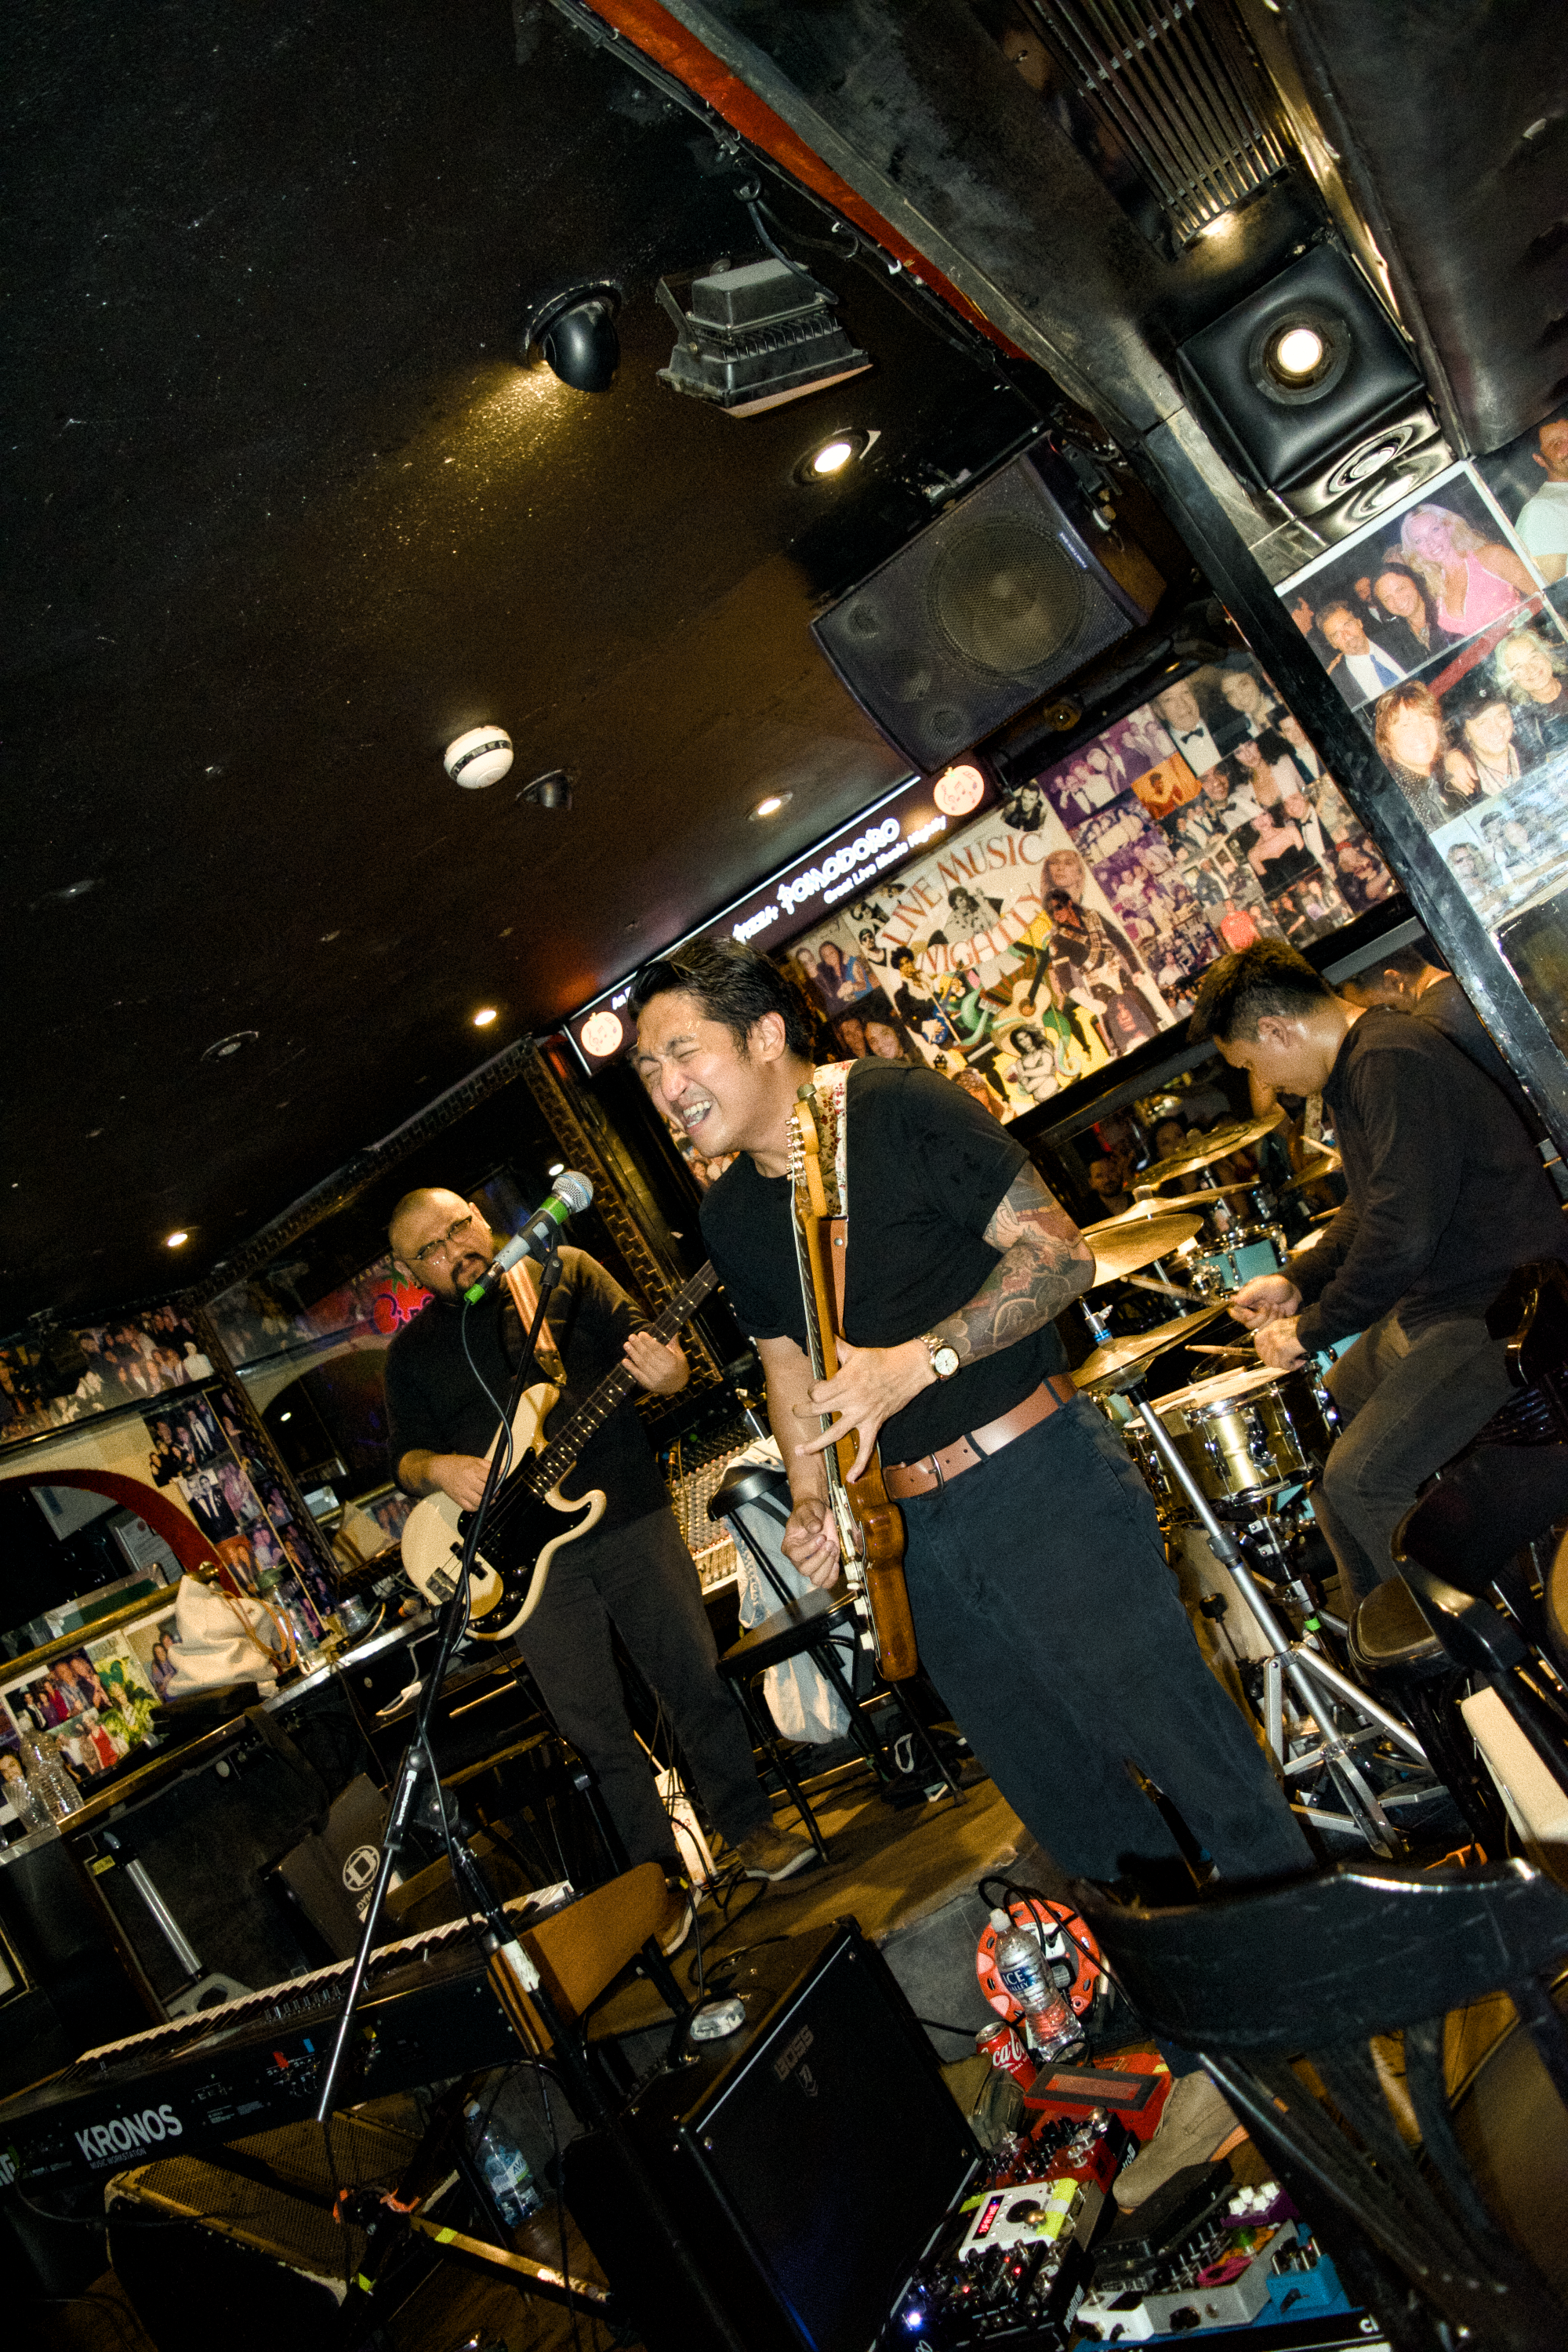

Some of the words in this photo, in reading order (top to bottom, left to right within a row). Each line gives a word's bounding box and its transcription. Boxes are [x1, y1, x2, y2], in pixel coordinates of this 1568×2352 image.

[777, 818, 900, 915] POMODORO
[852, 863, 877, 886] Live
[875, 841, 909, 870] Music
[881, 876, 942, 946] LIVE
[937, 831, 1046, 893] MUSIC
[920, 883, 1044, 973] NIGHTLY
[1002, 1969, 1025, 1985] ICE
[1009, 1981, 1029, 1991] ALLEY
[774, 2024, 815, 2082] BOSS
[74, 2104, 183, 2161] KRONOS
